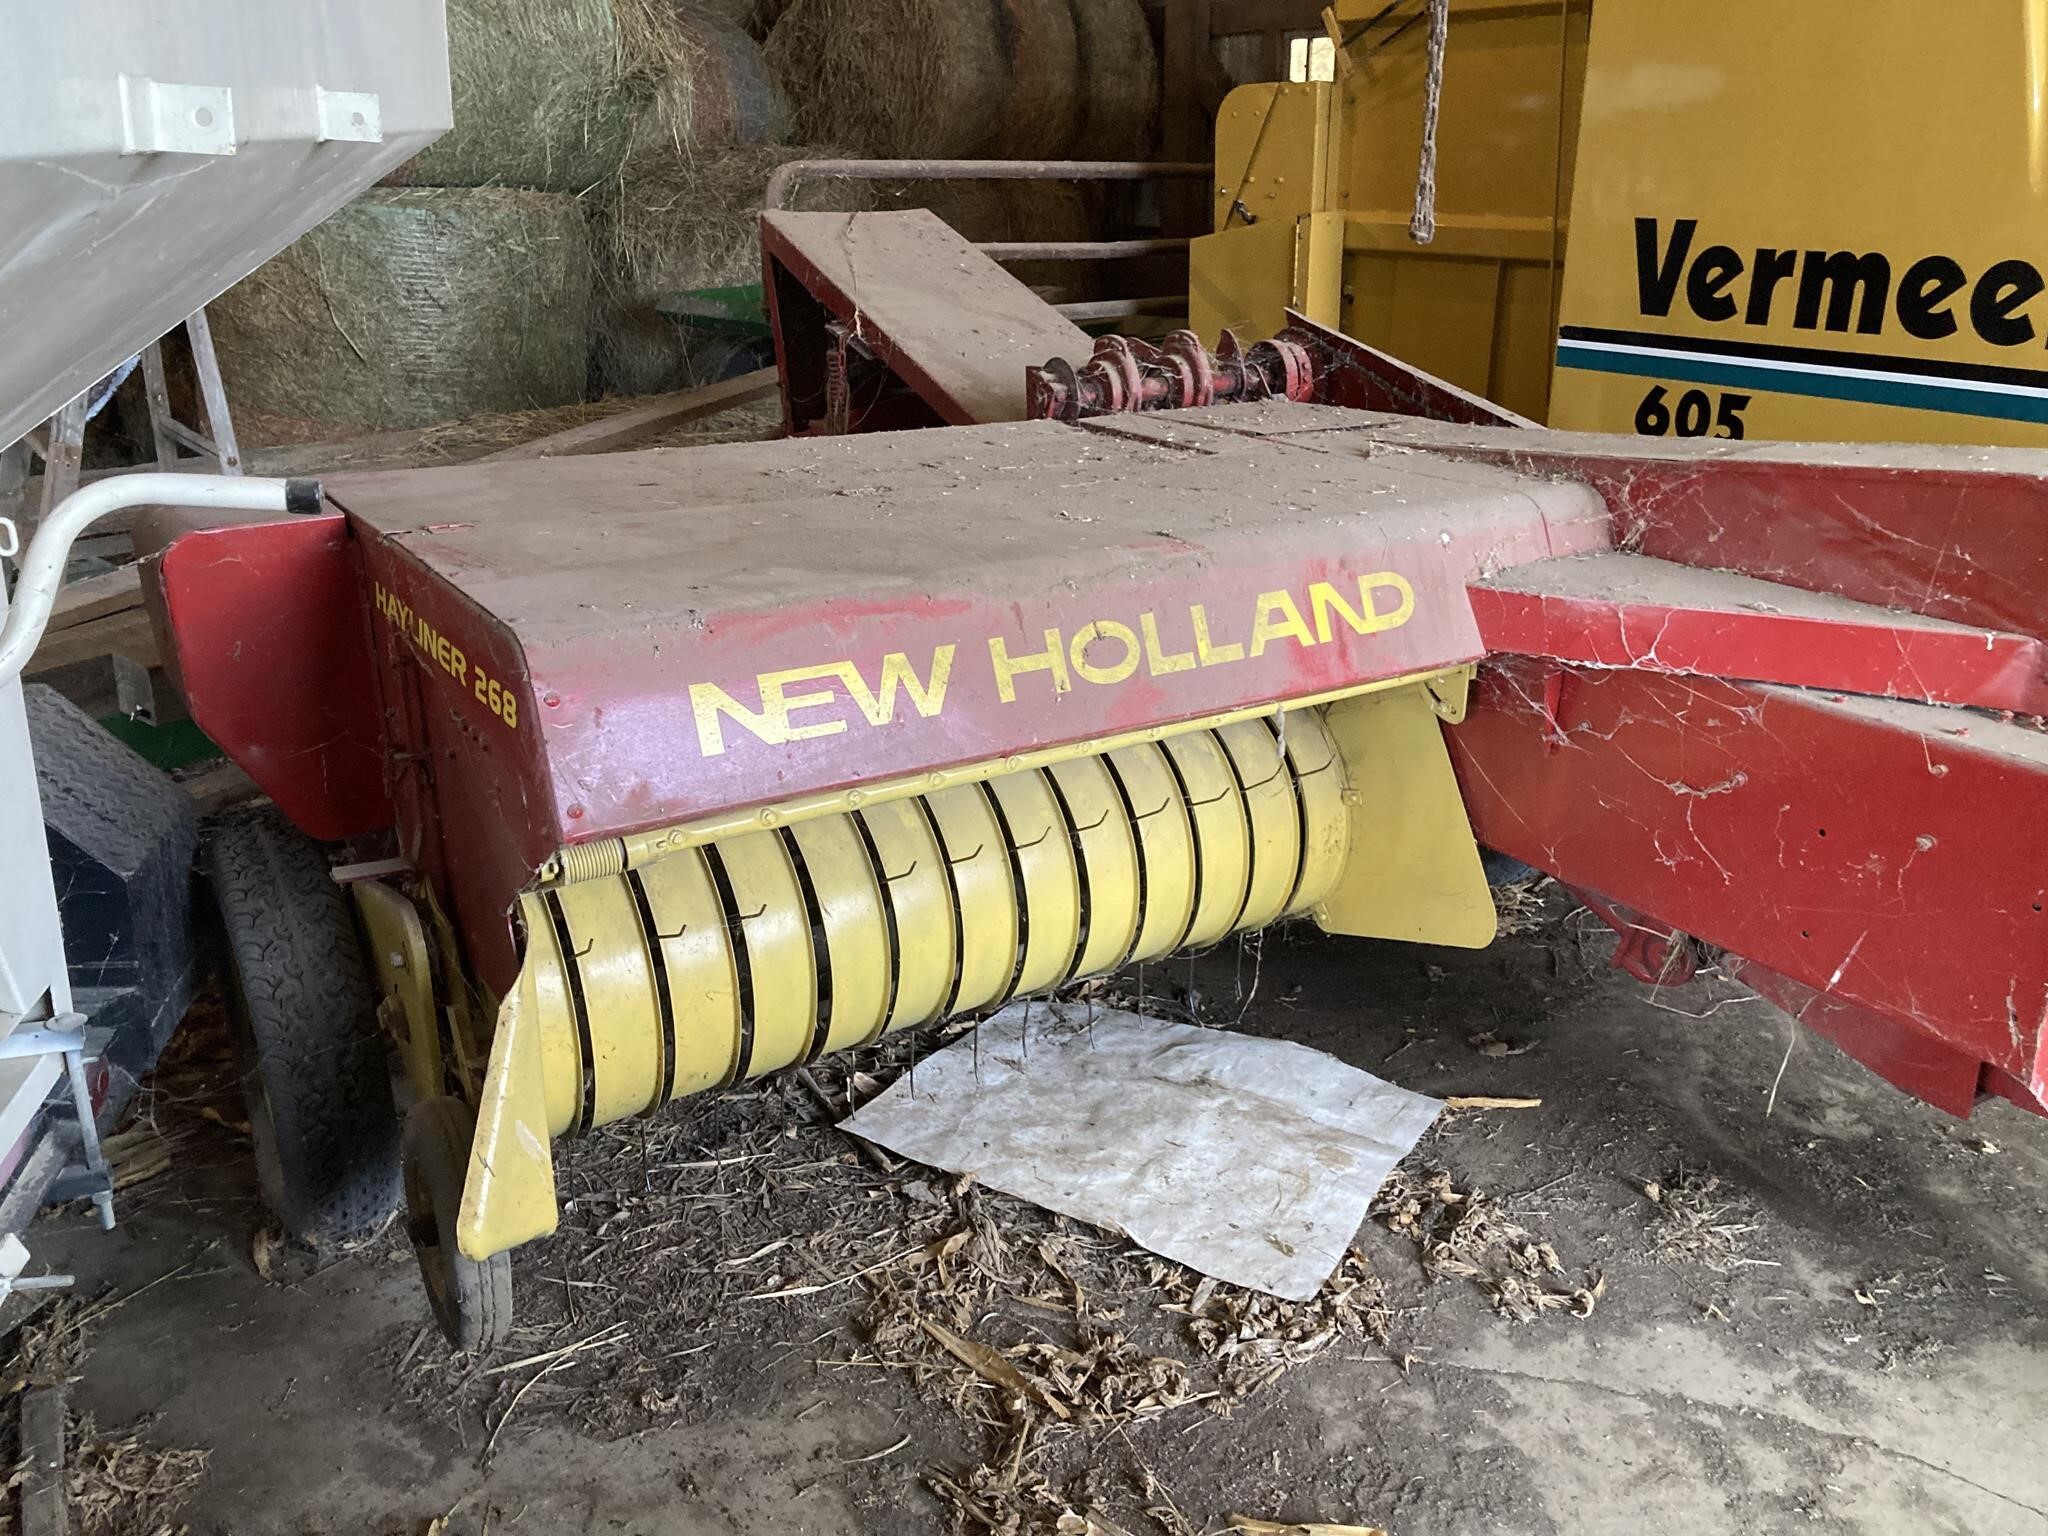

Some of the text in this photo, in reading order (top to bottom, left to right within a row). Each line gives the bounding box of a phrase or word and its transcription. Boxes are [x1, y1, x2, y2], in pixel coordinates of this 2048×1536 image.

[1634, 217, 2048, 348] Vermee
[1634, 385, 1752, 440] 605
[375, 582, 517, 729] HAYLINER 268
[688, 571, 1416, 758] NEW HOLLAND
